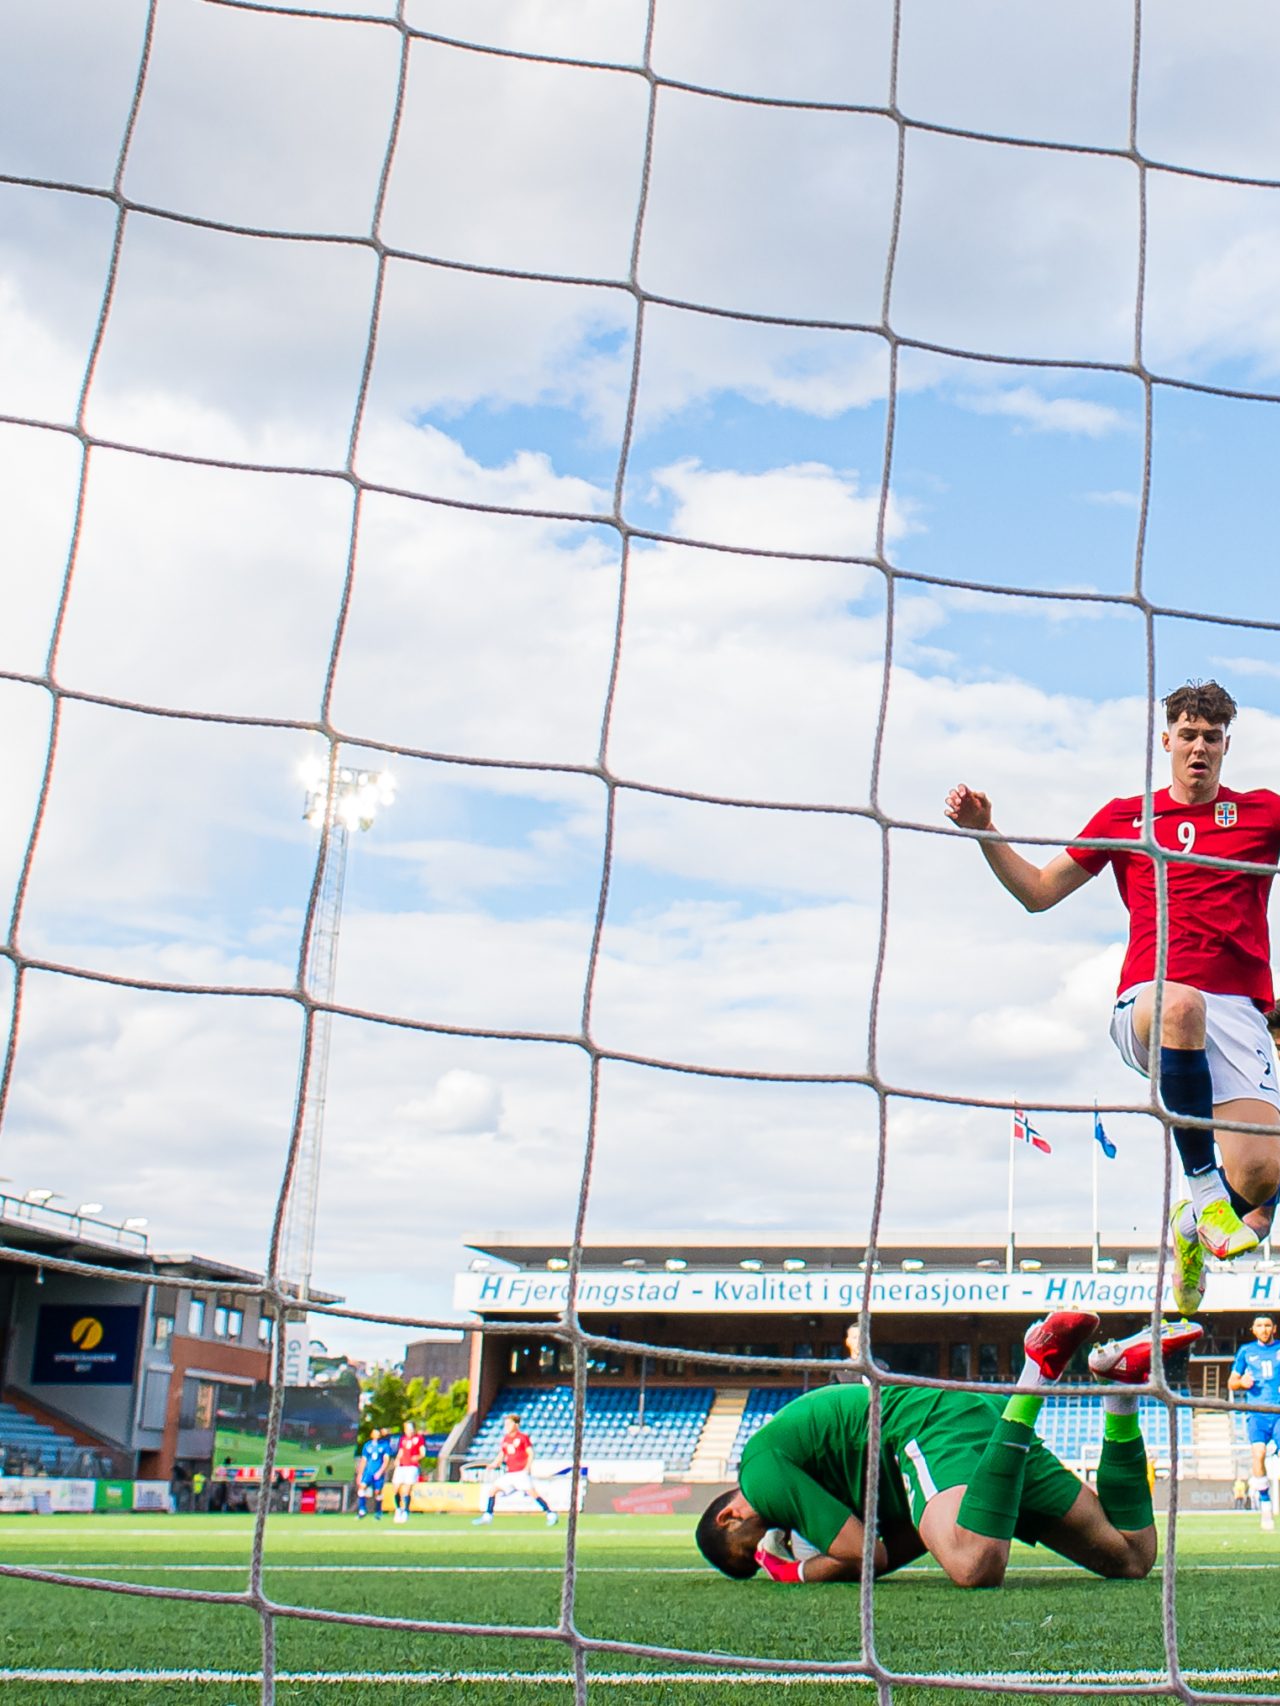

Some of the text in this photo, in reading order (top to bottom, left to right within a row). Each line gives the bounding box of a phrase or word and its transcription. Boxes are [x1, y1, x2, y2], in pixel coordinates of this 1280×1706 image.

[1177, 821, 1196, 855] 9
[714, 1278, 813, 1300] Kvalitet
[823, 1279, 829, 1300] i
[839, 1278, 1010, 1306] generasjoner
[1072, 1280, 1173, 1305] Magnor
[1261, 1360, 1274, 1379] 11
